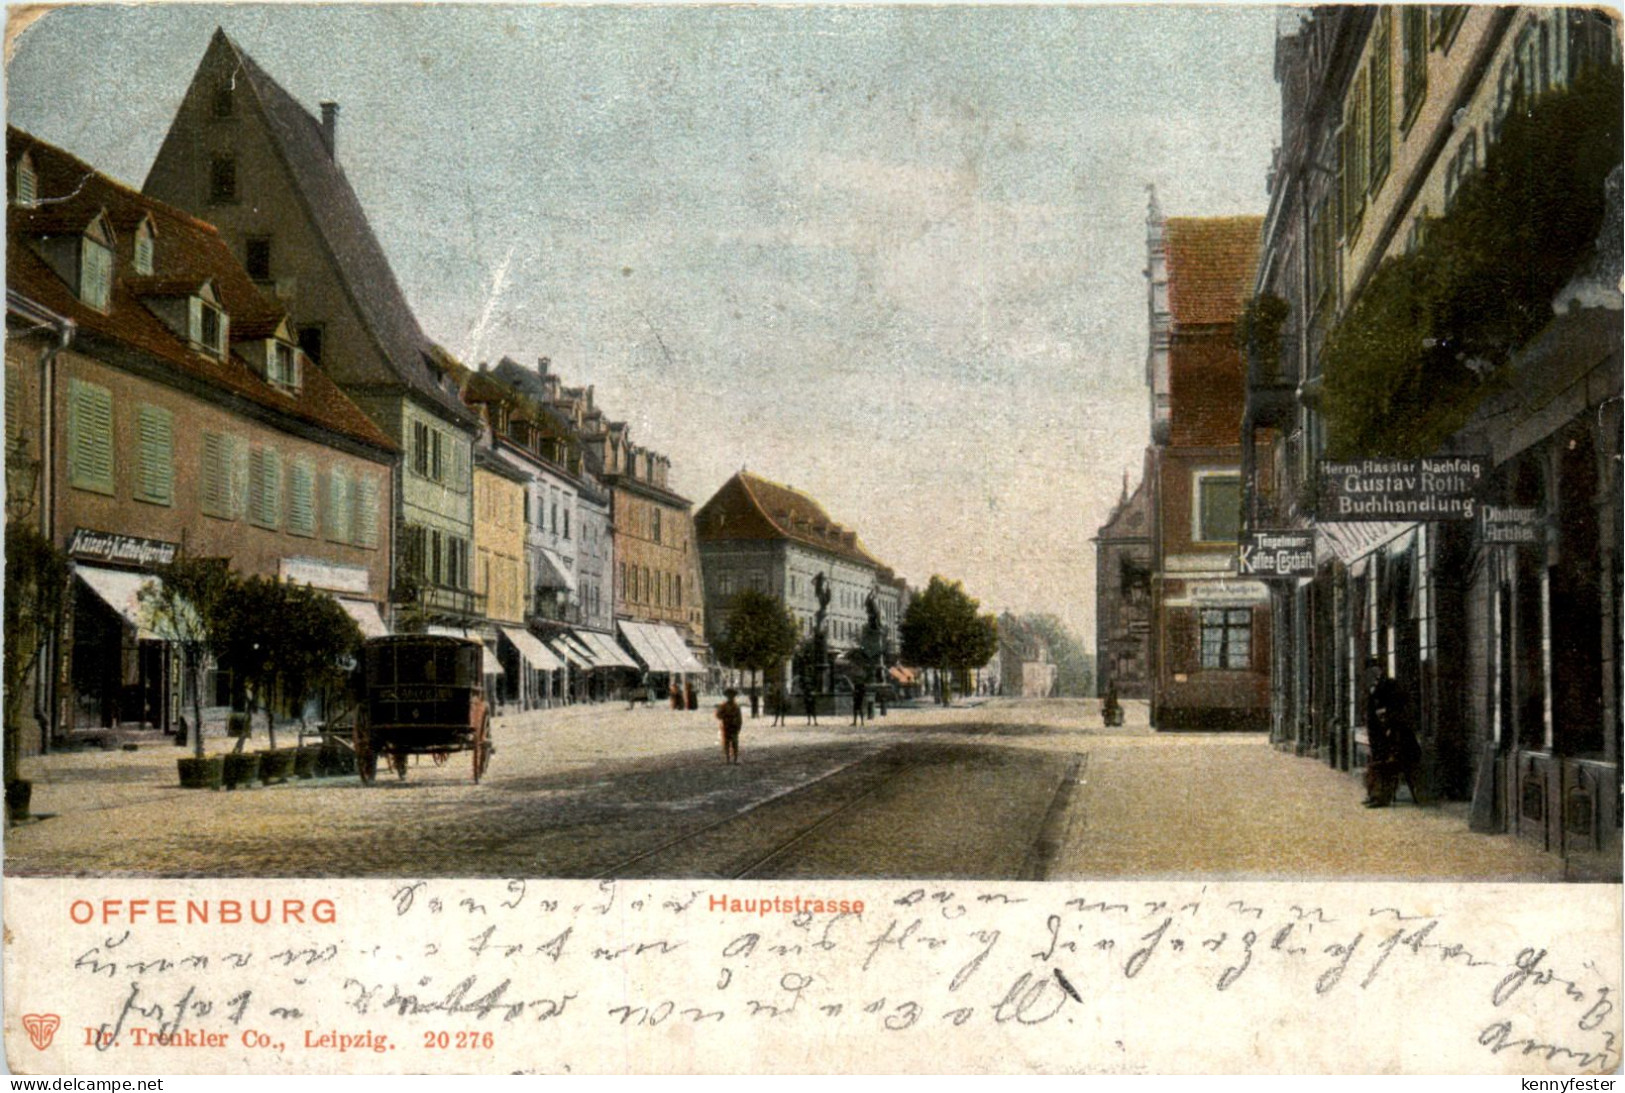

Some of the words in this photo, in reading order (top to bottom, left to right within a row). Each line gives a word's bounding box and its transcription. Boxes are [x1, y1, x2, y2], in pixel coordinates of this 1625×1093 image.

[1421, 459, 1480, 478] Nachfolg
[1344, 474, 1416, 493] Gustav
[1340, 495, 1475, 518] Buchhandlung
[69, 899, 338, 925] OFFENBURG
[708, 894, 865, 917] Hauptstrasse
[84, 1027, 119, 1047] Dr.
[131, 1027, 229, 1048] Trenkler
[241, 1028, 287, 1050] Co.,
[304, 1028, 396, 1052] Leipzig.
